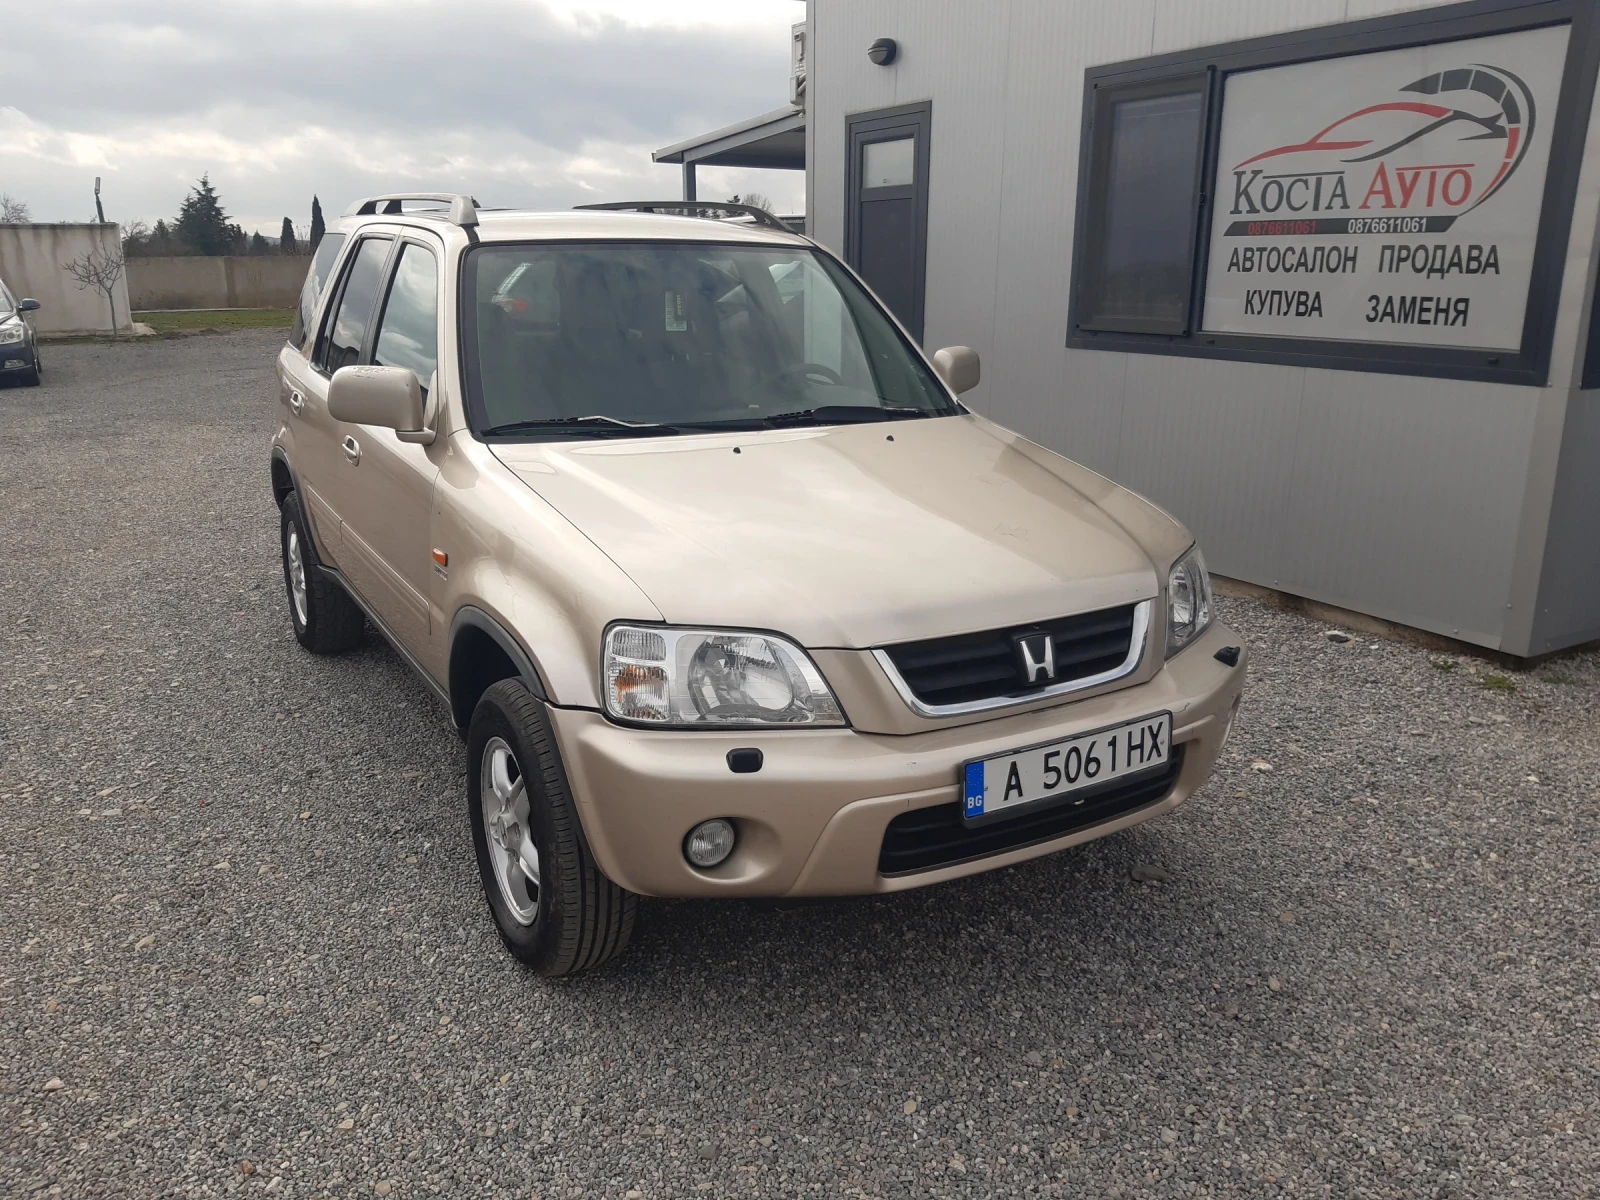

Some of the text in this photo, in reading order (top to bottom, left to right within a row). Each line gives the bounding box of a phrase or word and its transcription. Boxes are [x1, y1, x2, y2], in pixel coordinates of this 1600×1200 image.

[1248, 217, 1427, 236] 0876611061 0876611061
[1227, 244, 1501, 280] АВТОСАЛОН ПРОДАВА
[1244, 289, 1470, 327] КУПУВА ЗАМЕНЯ
[1003, 760, 1024, 802] A
[967, 795, 983, 809] BG
